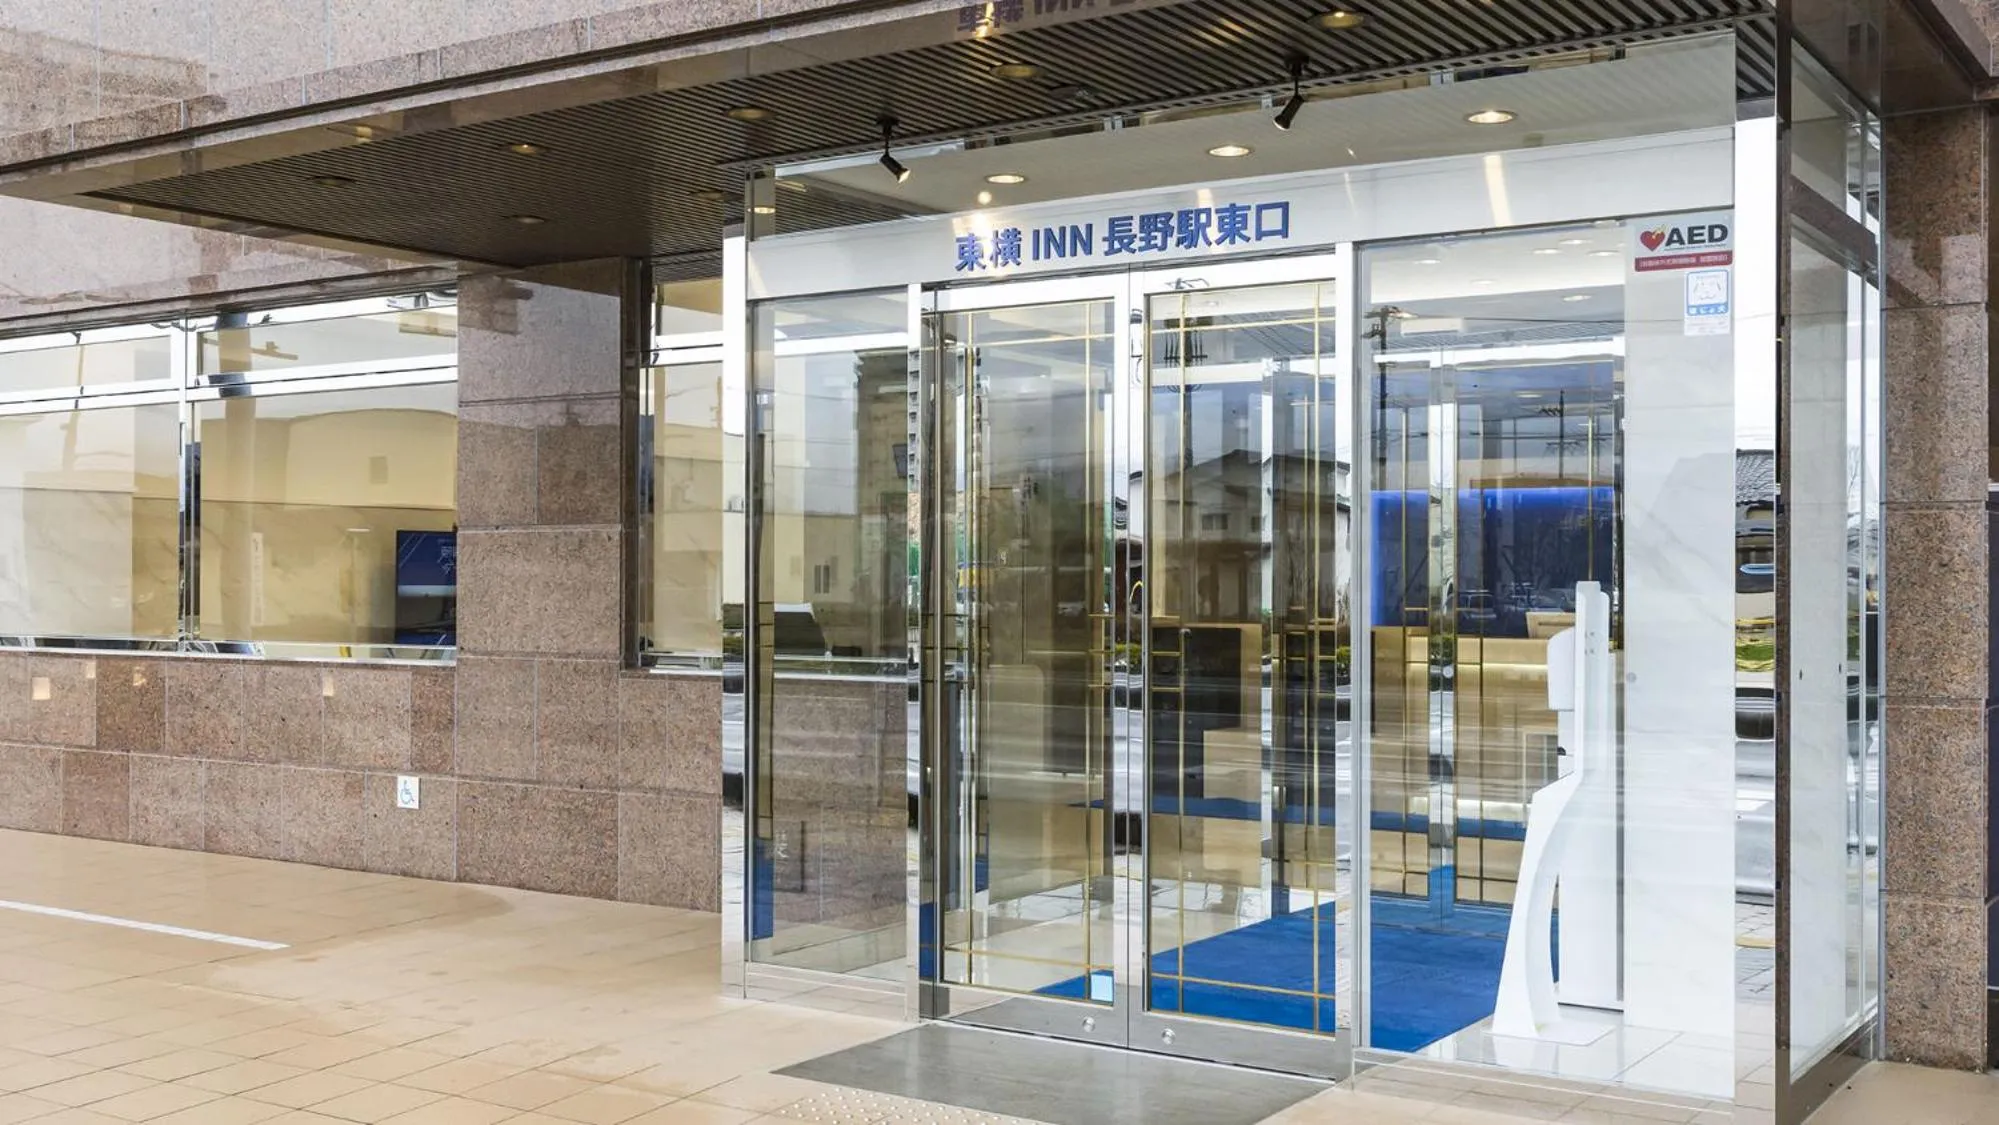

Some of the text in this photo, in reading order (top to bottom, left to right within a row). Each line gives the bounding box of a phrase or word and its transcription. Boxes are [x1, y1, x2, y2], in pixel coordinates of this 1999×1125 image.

[955, 201, 1290, 272] 東横 INN 長野駅東口
[1665, 223, 1728, 246] AED
